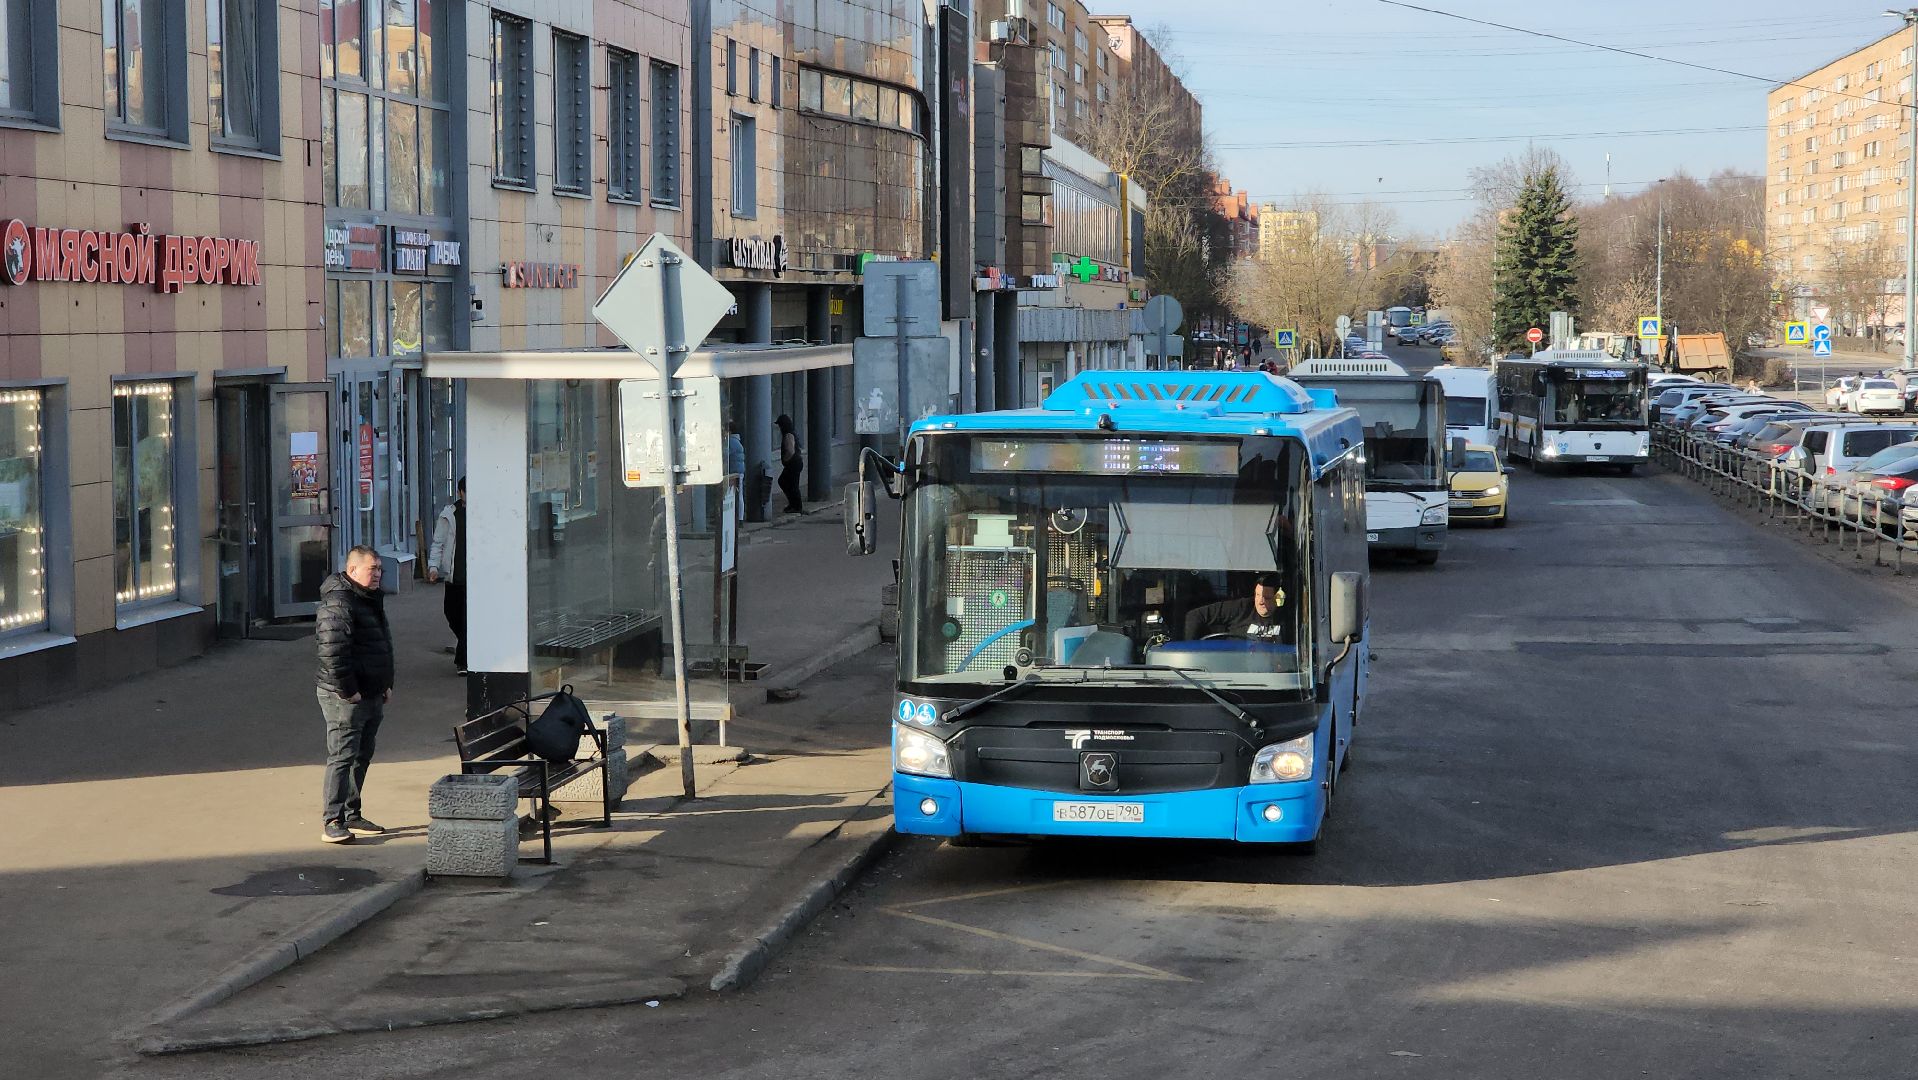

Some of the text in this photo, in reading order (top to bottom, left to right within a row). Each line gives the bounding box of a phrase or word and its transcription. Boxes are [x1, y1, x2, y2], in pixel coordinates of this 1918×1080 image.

[328, 227, 350, 249] дрый
[36, 222, 262, 294] МЯСНОЙ ДВОРИК
[402, 247, 427, 270] ГРАНТ
[433, 240, 461, 265] ТАБАК
[733, 237, 776, 269] GASTROBAR
[1118, 805, 1140, 817] 790
